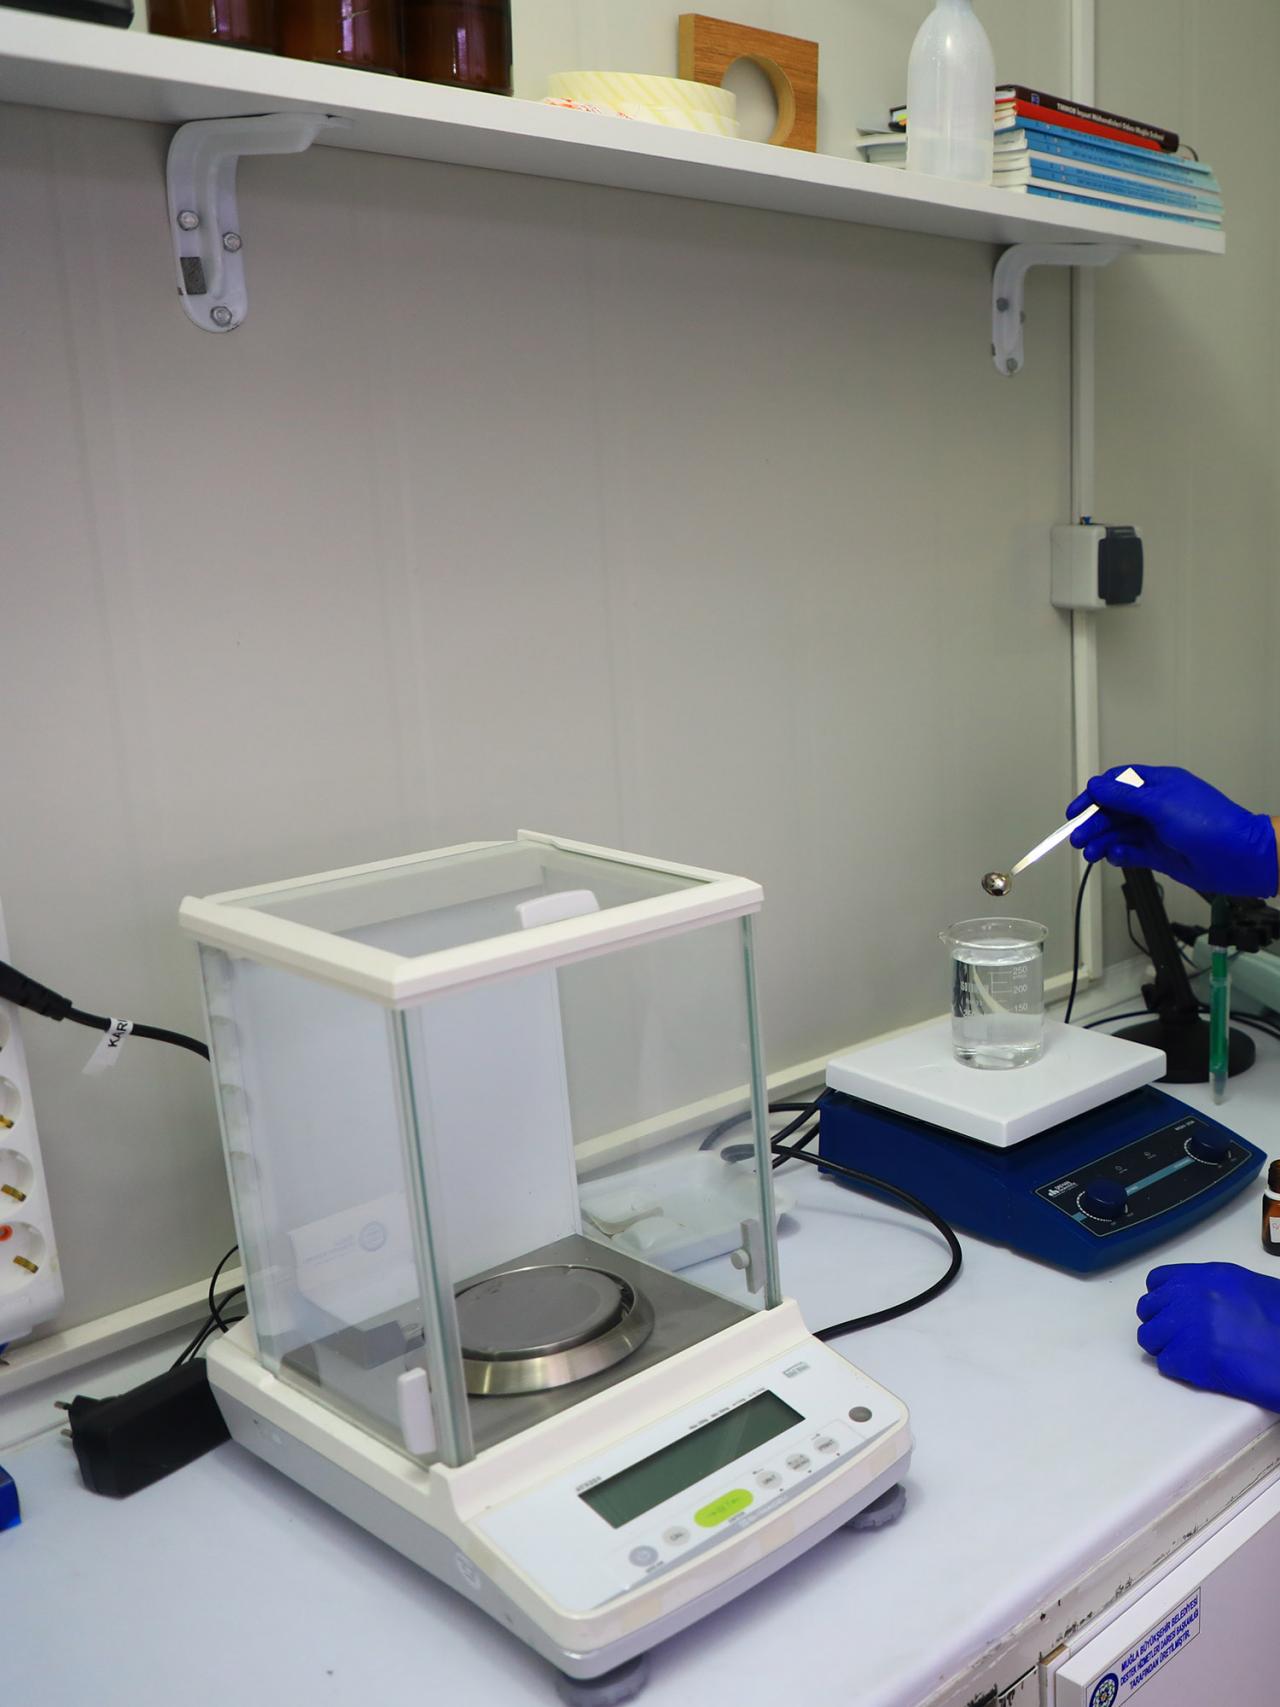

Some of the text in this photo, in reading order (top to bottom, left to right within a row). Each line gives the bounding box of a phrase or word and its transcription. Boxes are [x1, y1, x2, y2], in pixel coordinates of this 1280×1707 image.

[1013, 966, 1028, 976] 250
[1013, 984, 1028, 994] 200
[1121, 1649, 1140, 1672] MUĞLA
